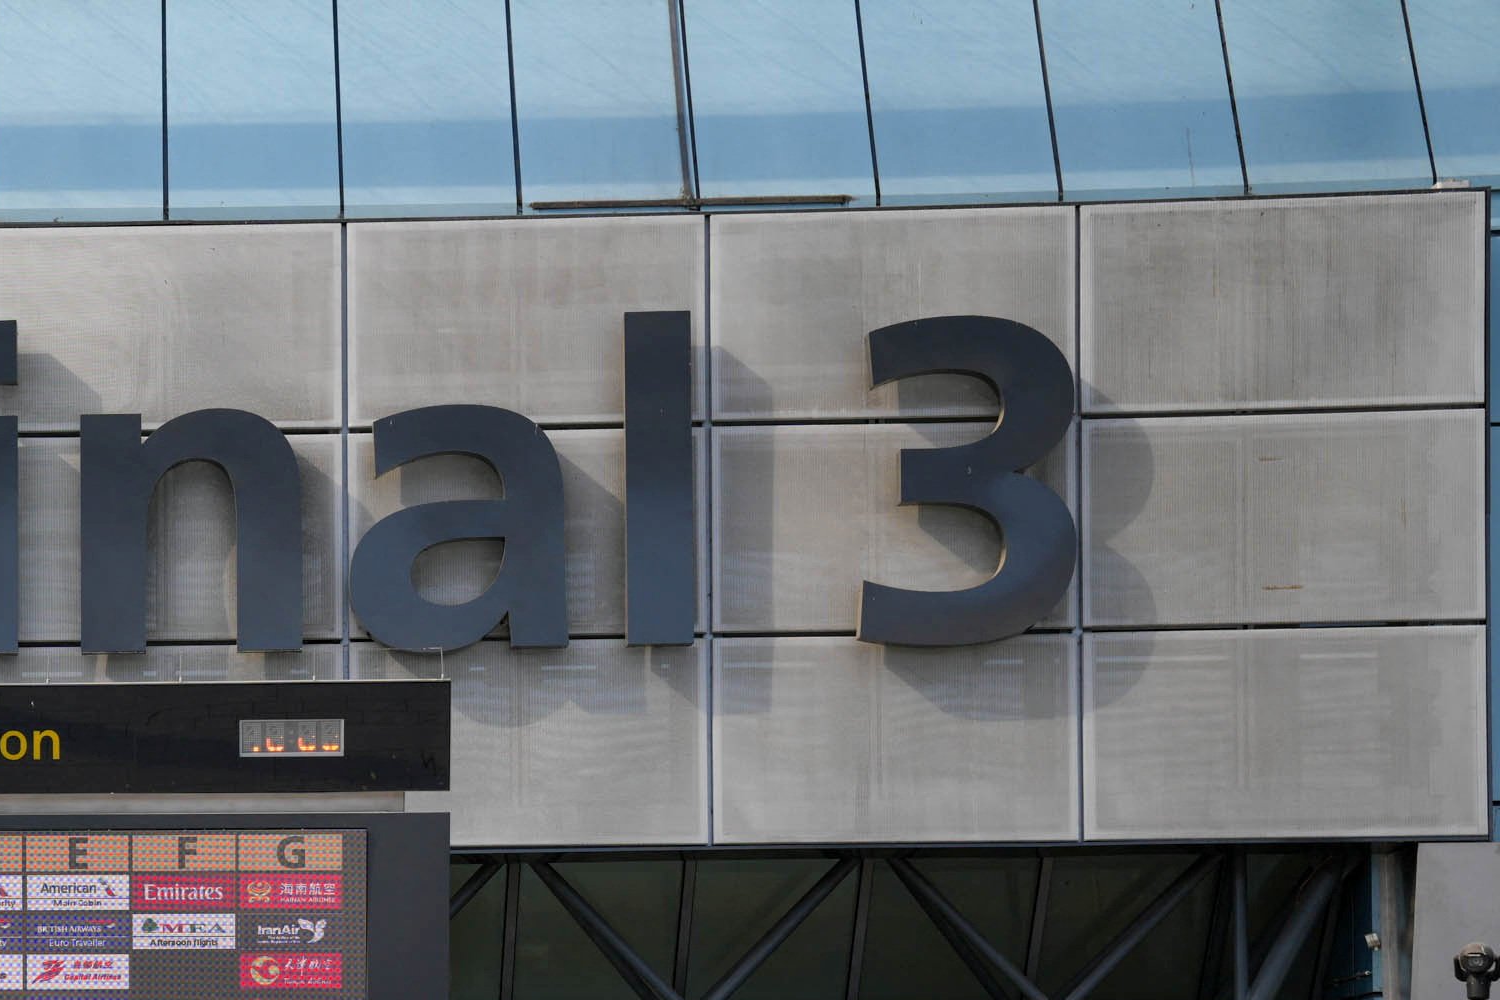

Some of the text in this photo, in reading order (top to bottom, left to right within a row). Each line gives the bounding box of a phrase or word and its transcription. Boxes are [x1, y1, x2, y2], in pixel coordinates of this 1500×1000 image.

[857, 315, 1077, 648] 3
[68, 837, 89, 869] E
[178, 836, 198, 869] F
[276, 836, 306, 869] G
[40, 883, 97, 894] American
[144, 883, 224, 900] Emirates
[257, 924, 300, 935] IranAir
[49, 938, 106, 947] Euro Traveller
[193, 939, 219, 948] flights
